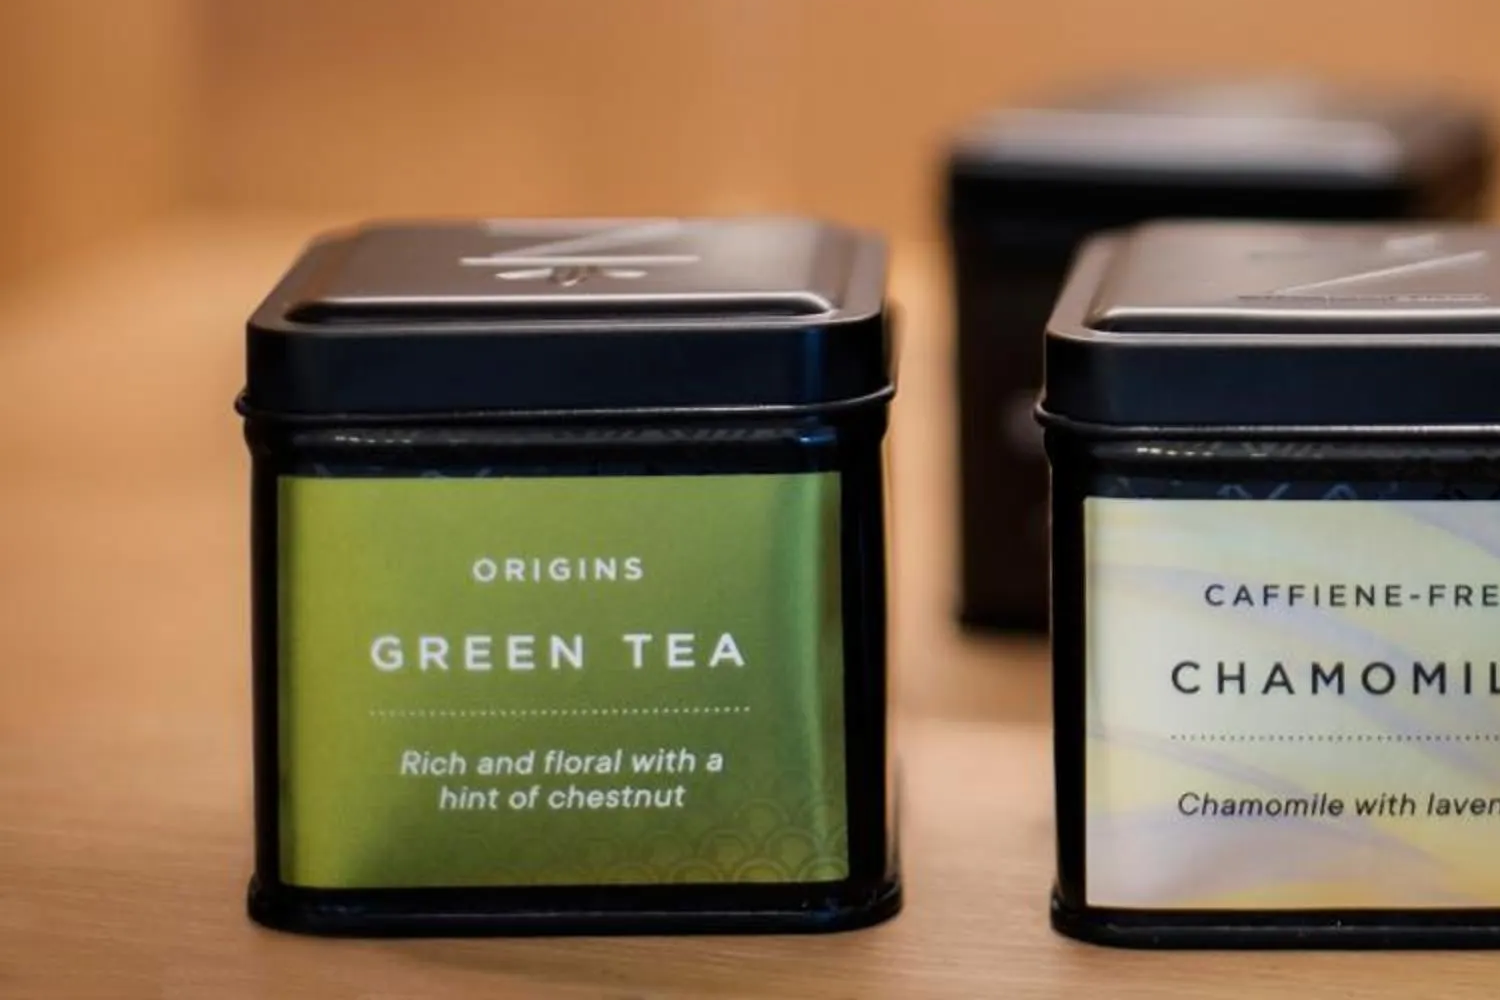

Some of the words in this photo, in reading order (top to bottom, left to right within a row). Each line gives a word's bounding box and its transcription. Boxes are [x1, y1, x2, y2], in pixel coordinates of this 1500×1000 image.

[472, 556, 643, 582] ORIGINS
[370, 634, 583, 671] GREEN
[622, 632, 746, 669] TEA
[400, 750, 466, 775] Rich
[476, 749, 535, 774] and
[544, 748, 622, 774] floral
[631, 747, 696, 773] with
[705, 752, 723, 772] a
[439, 785, 499, 810] hint
[508, 784, 539, 809] of
[547, 784, 686, 810] chestnut
[1177, 791, 1344, 817] Chamomile
[1354, 792, 1417, 817] with
